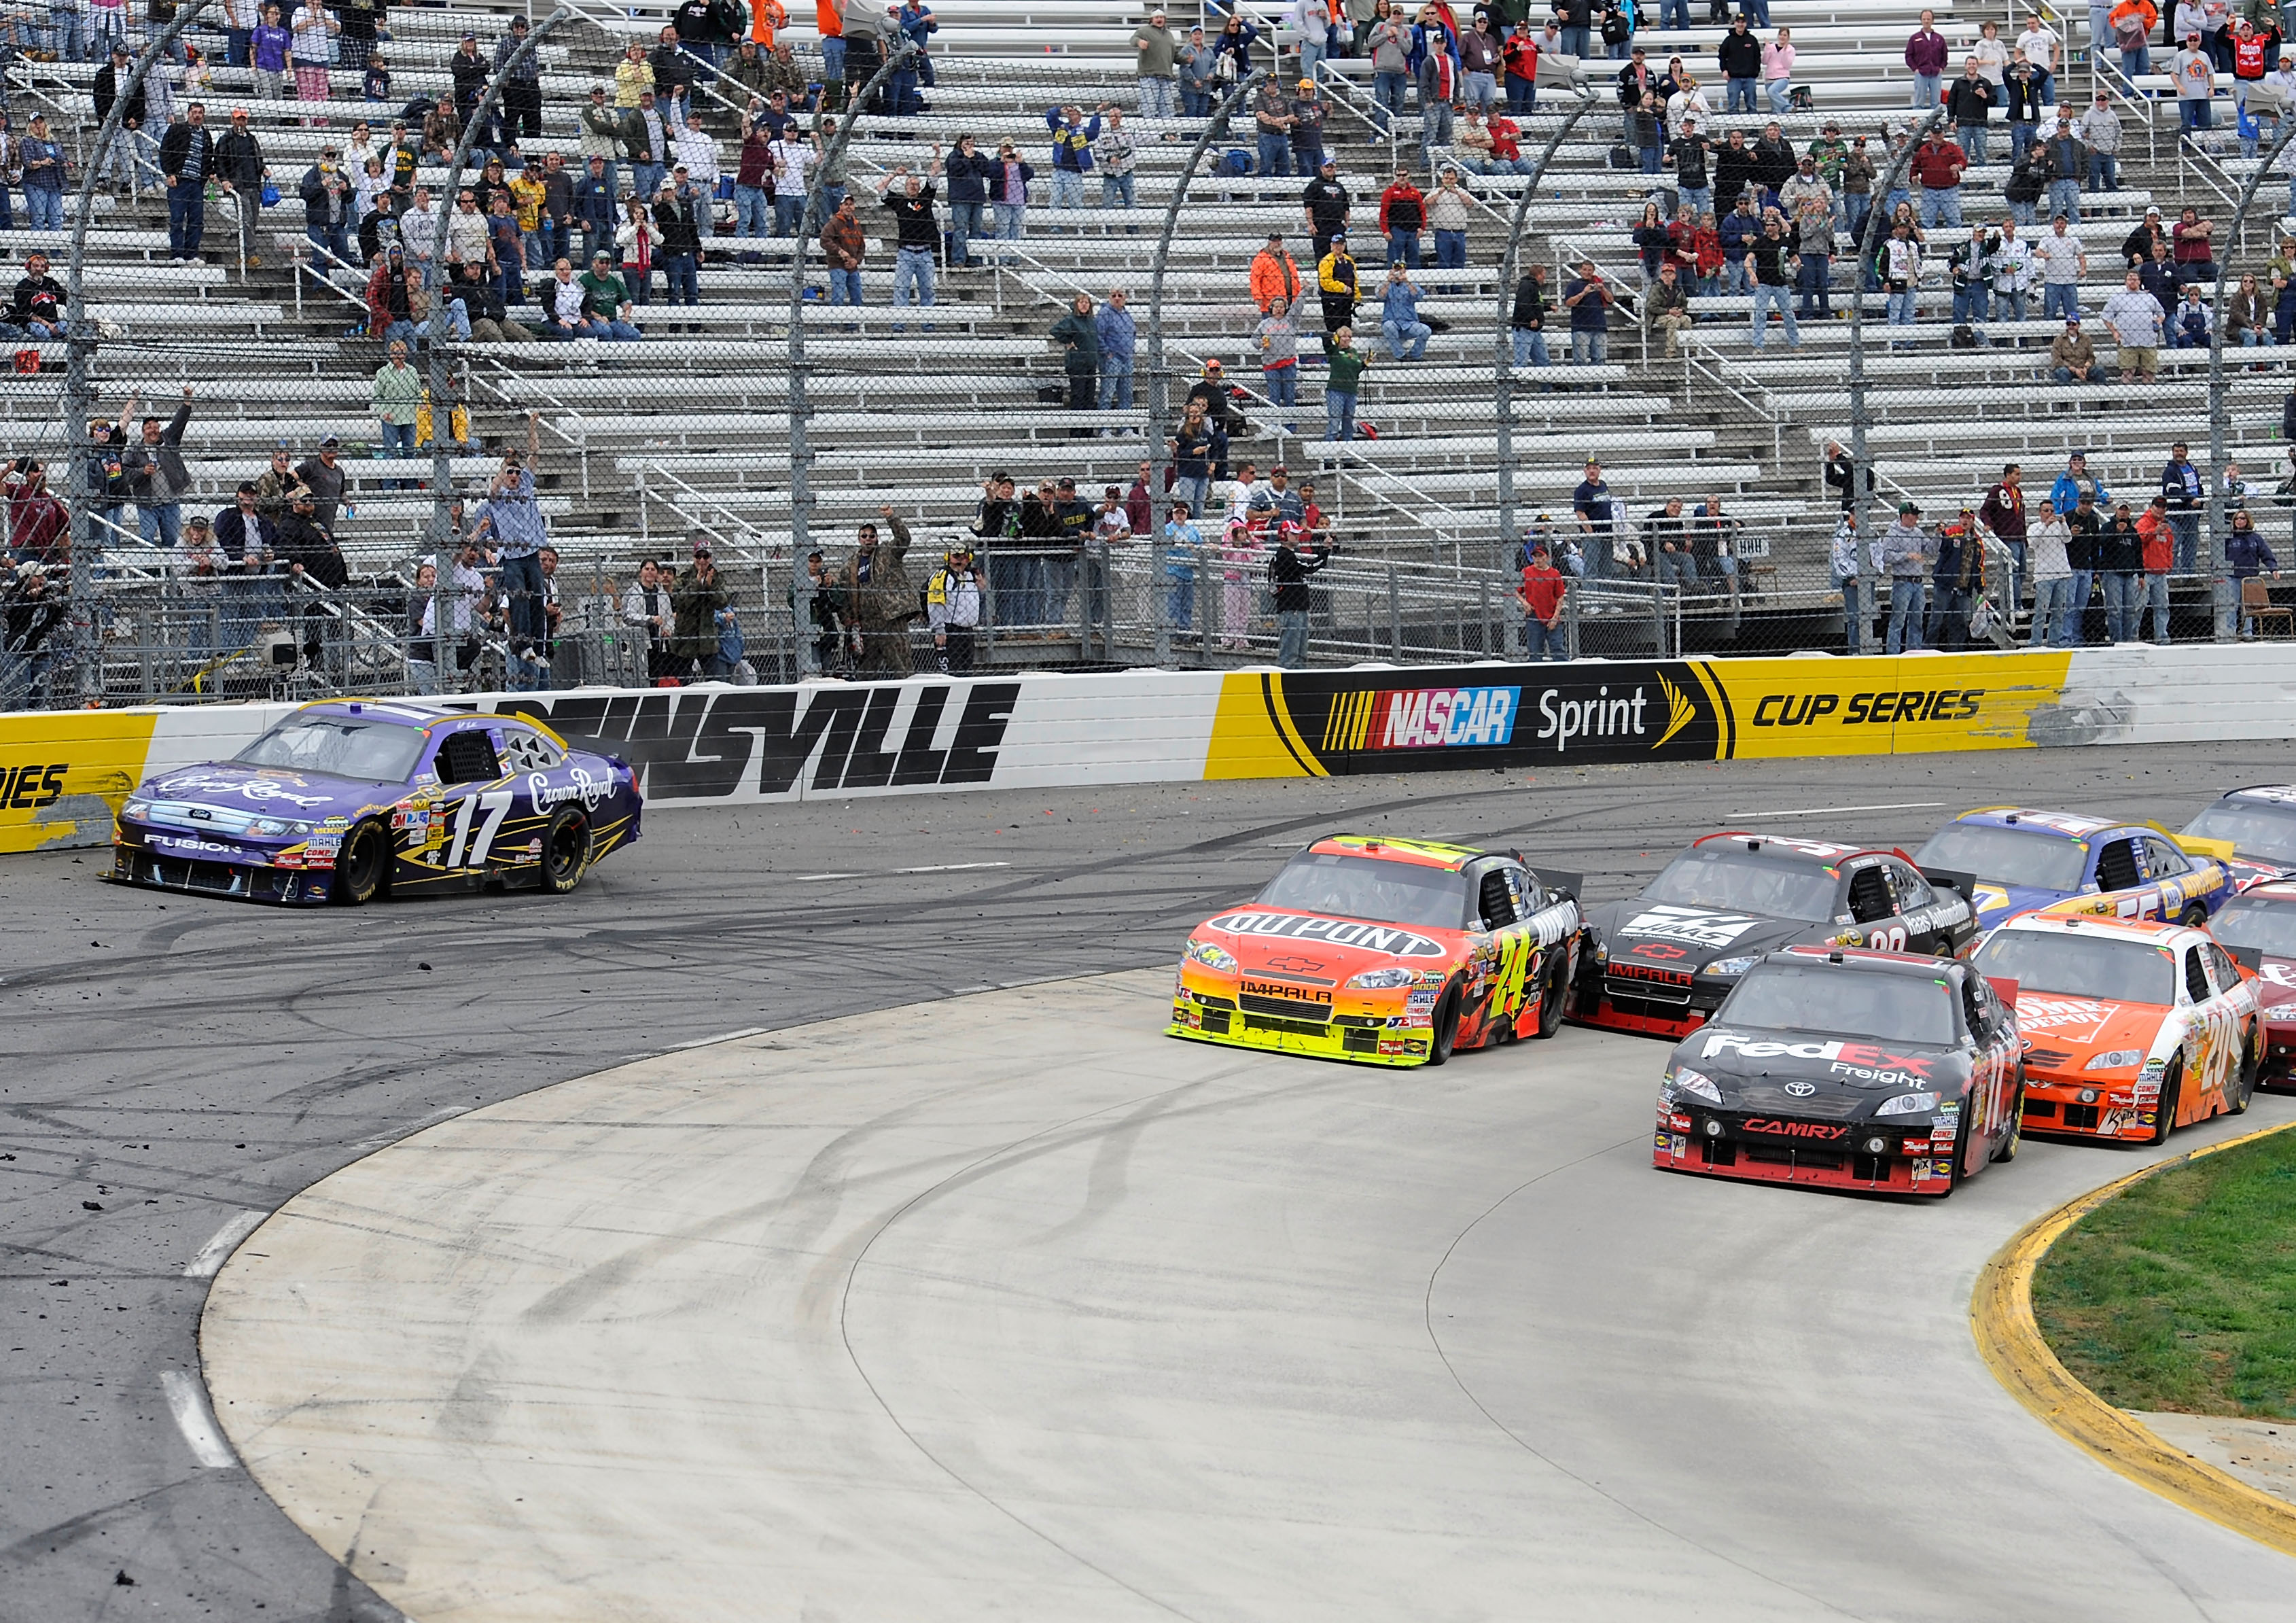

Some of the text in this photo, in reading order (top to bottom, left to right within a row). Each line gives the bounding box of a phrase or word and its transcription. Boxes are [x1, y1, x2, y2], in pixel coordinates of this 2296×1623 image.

[1383, 686, 1985, 752] NASCAR Sprint CUP SERIES
[529, 767, 618, 815] Crown Royal
[446, 791, 513, 867] 17
[143, 834, 243, 854] FUSION
[308, 838, 341, 847] MAHLE
[1638, 923, 1723, 940] HAAS
[1489, 927, 1530, 1019] 24
[1608, 963, 1693, 985] IMPALA
[1241, 980, 1332, 1003] IMPALA
[1387, 1017, 1411, 1028] JE
[1701, 1034, 1935, 1078] FedEx
[1742, 1118, 1848, 1140] CAMRY
[1933, 1116, 1958, 1127] MAHLE
